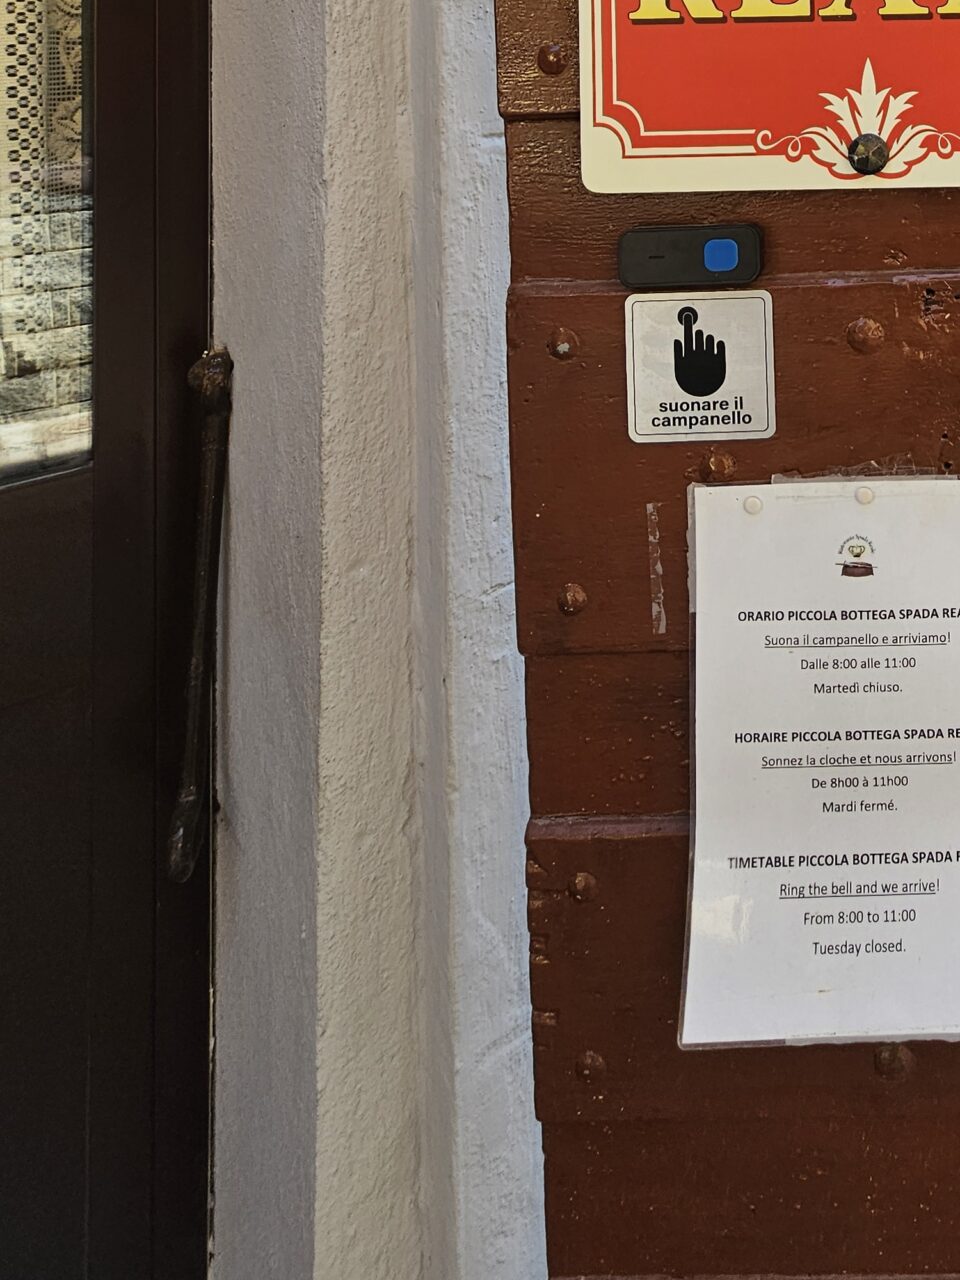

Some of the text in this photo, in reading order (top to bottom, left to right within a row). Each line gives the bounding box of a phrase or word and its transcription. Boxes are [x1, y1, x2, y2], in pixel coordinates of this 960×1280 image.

[658, 396, 744, 413] suonare il
[651, 411, 753, 429] campanello
[737, 610, 785, 623] ORARIO
[788, 610, 838, 622] PICCOLA
[840, 609, 897, 621] BOTTEGA
[898, 608, 940, 620] SPADA
[764, 631, 952, 646] Suona il campanello e arriviamo!
[800, 656, 917, 671] Dalle 8:00 alle 11:00
[813, 681, 904, 695] Martedì chiuso.
[734, 731, 789, 744] HORAIRE
[791, 730, 843, 743] PICCOLA
[845, 729, 902, 742] BOTTEGA
[903, 728, 945, 740] SPADA
[761, 751, 958, 767] Sonnez la cloche et nous arrivons!
[811, 775, 910, 789] De 8h00 à 11h00
[822, 799, 899, 813] Mardi fermé.
[727, 855, 796, 869] TIMETABLE
[797, 853, 850, 867] PICCOLA
[852, 852, 910, 866] BOTTEGA
[911, 851, 954, 864] SPADA
[779, 879, 941, 899] Ring the bell and we arrive!
[803, 909, 917, 926] From 8:00 to 11:00
[812, 939, 907, 957] Tuesday closed.
